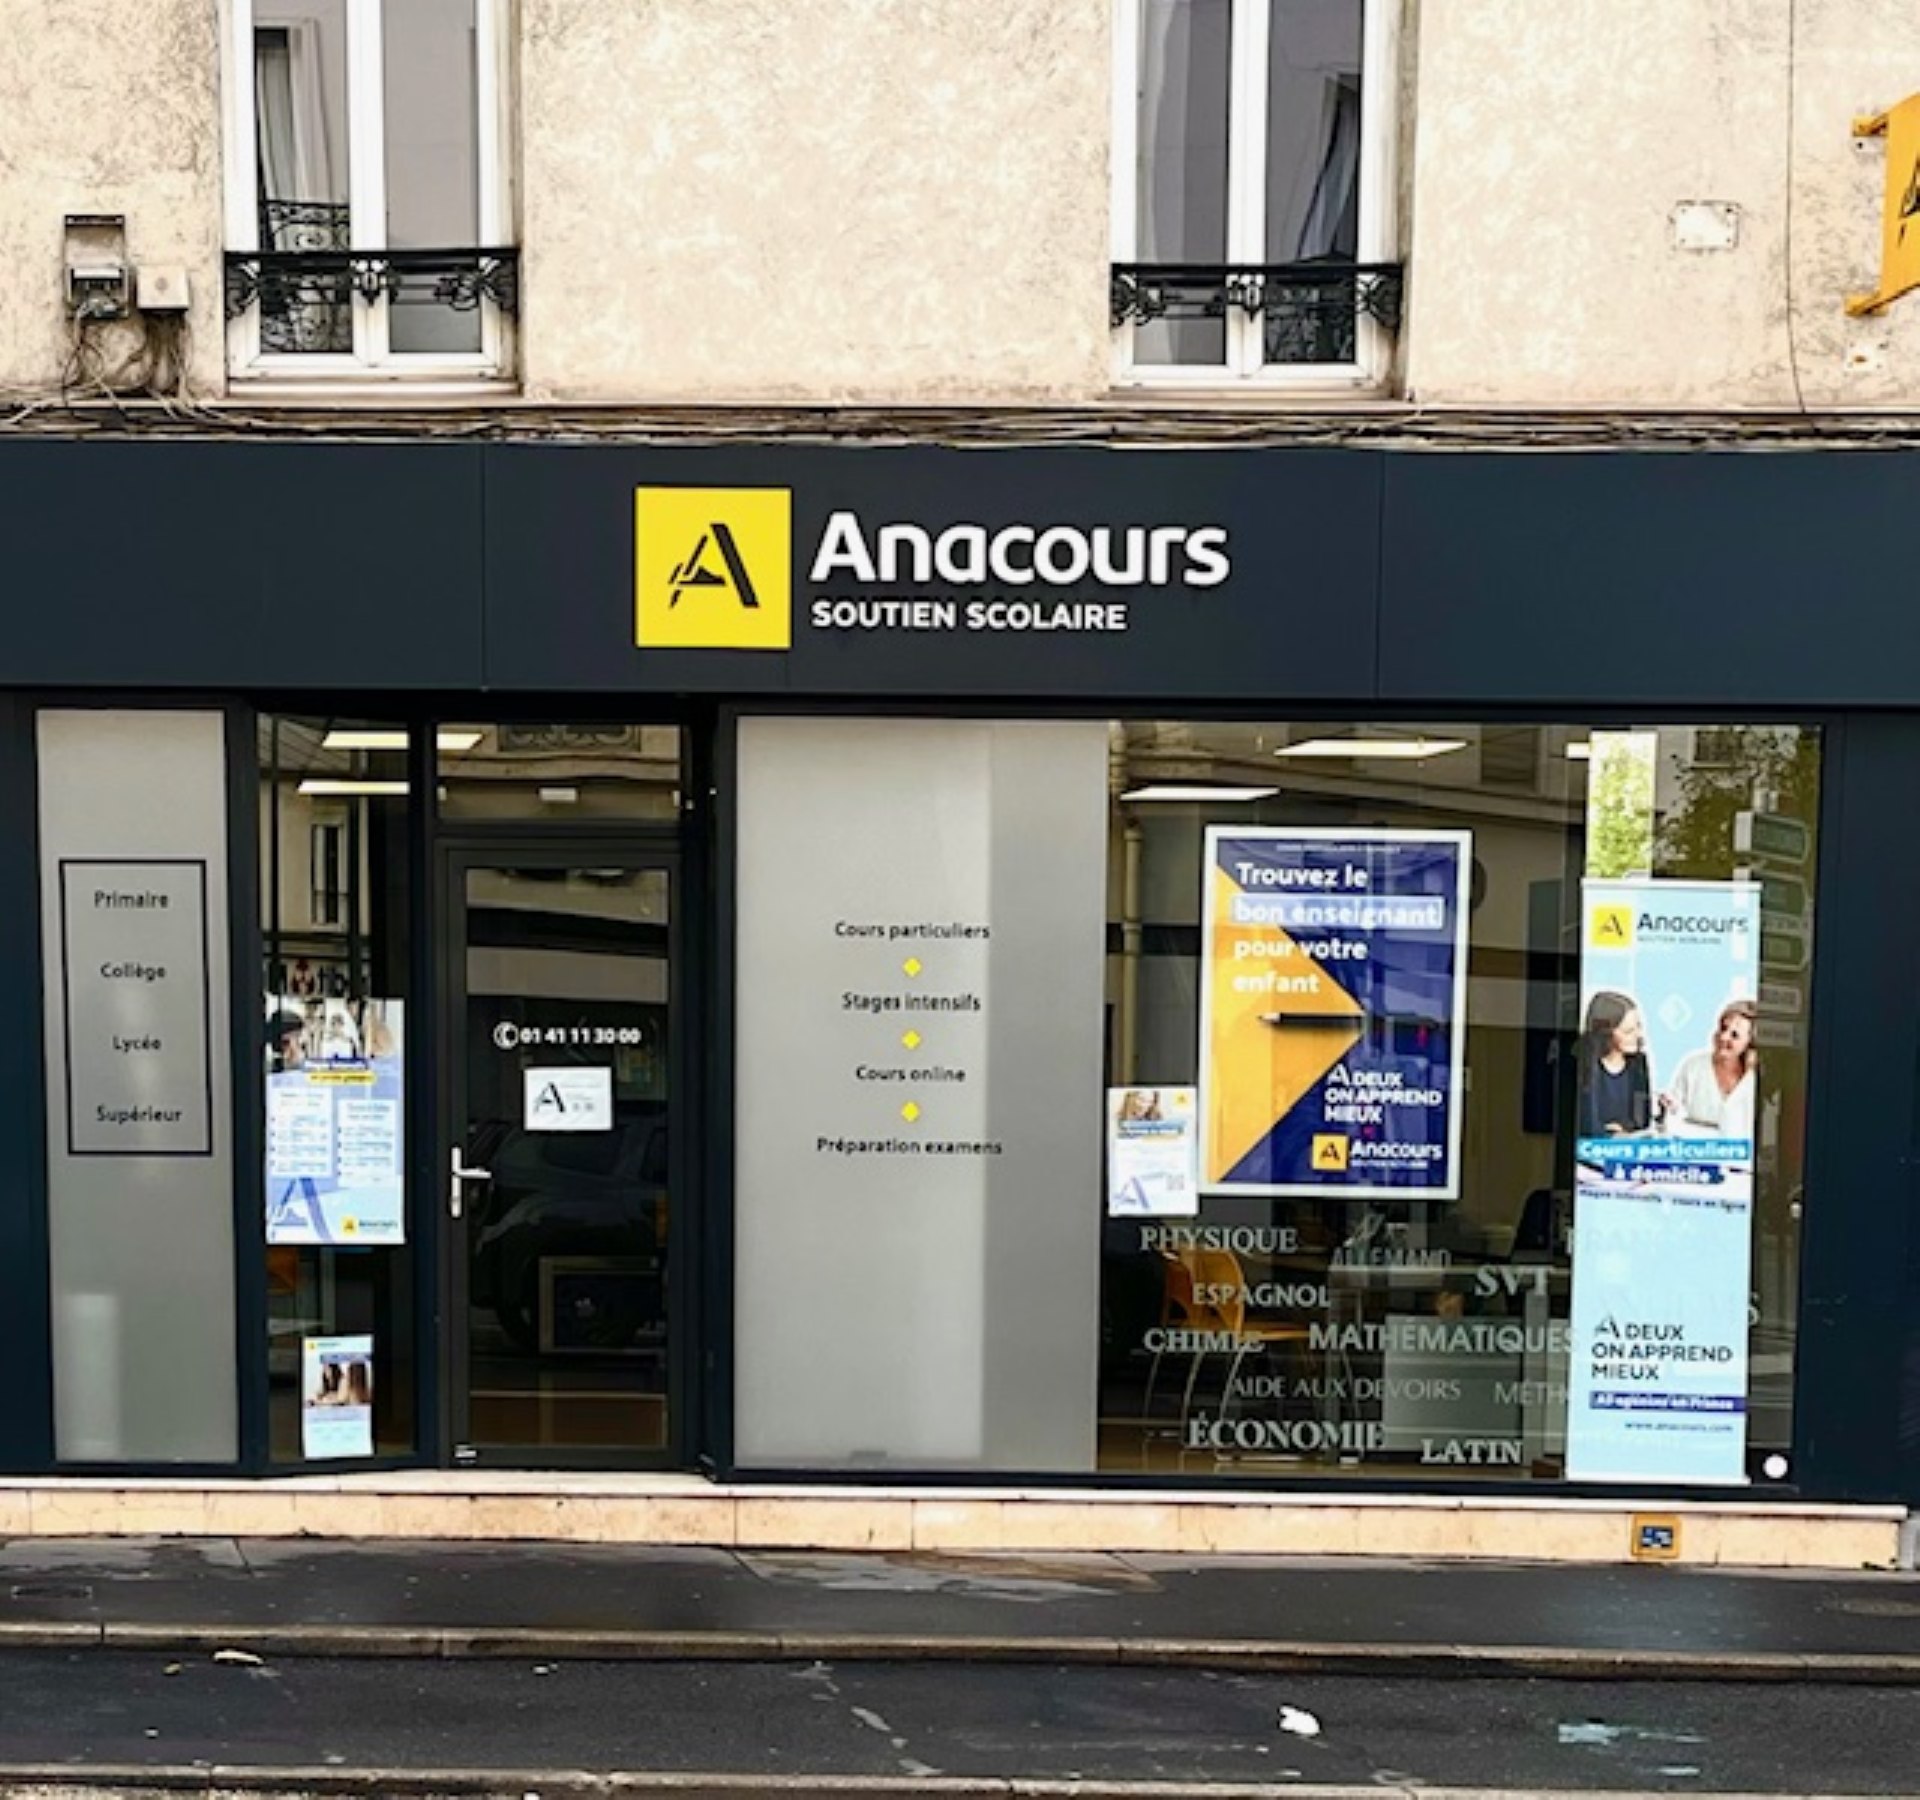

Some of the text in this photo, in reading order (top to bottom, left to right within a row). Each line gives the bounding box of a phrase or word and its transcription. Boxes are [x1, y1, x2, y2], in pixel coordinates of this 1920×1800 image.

[810, 510, 1231, 586] Anacours
[812, 601, 1127, 632] SOUTIEN SCOLAIRE
[1235, 861, 1369, 887] Trouvez le
[94, 889, 169, 908] Primaire
[1234, 897, 1440, 930] bon enseignant
[1637, 912, 1749, 933] Anacours
[835, 921, 990, 940] Cours particuliers
[1234, 938, 1369, 962] pour votre
[100, 963, 166, 981] Collège
[1232, 973, 1320, 993] enfant
[842, 992, 981, 1013] Stages intensifs
[112, 1035, 162, 1052] Lycée
[520, 1027, 641, 1044] 01 41 11 30 00
[856, 1066, 966, 1082] Cours online
[1352, 1071, 1403, 1087] DEUX
[1324, 1087, 1443, 1106] ON APPREND
[96, 1105, 183, 1125] Supérieur
[1324, 1105, 1383, 1123] MIEUX
[816, 1137, 1002, 1155] Préparation examens
[1351, 1140, 1443, 1160] Anacours
[1578, 1143, 1747, 1161] Cours particuliers
[1630, 1165, 1711, 1183] domicile
[1140, 1227, 1298, 1255] PHYSIQUE
[1474, 1263, 1551, 1298] SVT
[1192, 1283, 1331, 1307] ESPAGNOL
[1143, 1327, 1266, 1353] CHIMIE
[1308, 1319, 1576, 1353] MATHÉMATIQUES
[1624, 1324, 1684, 1341] DEUX
[1591, 1342, 1734, 1363] ON APPREND
[1591, 1363, 1660, 1381] MIEUX
[1232, 1376, 1462, 1400] AIDE AUX DEVOIRS
[1493, 1376, 1571, 1405] MÉTH
[1188, 1411, 1386, 1451] ÉCONOMIE
[1420, 1437, 1524, 1465] LATIN
